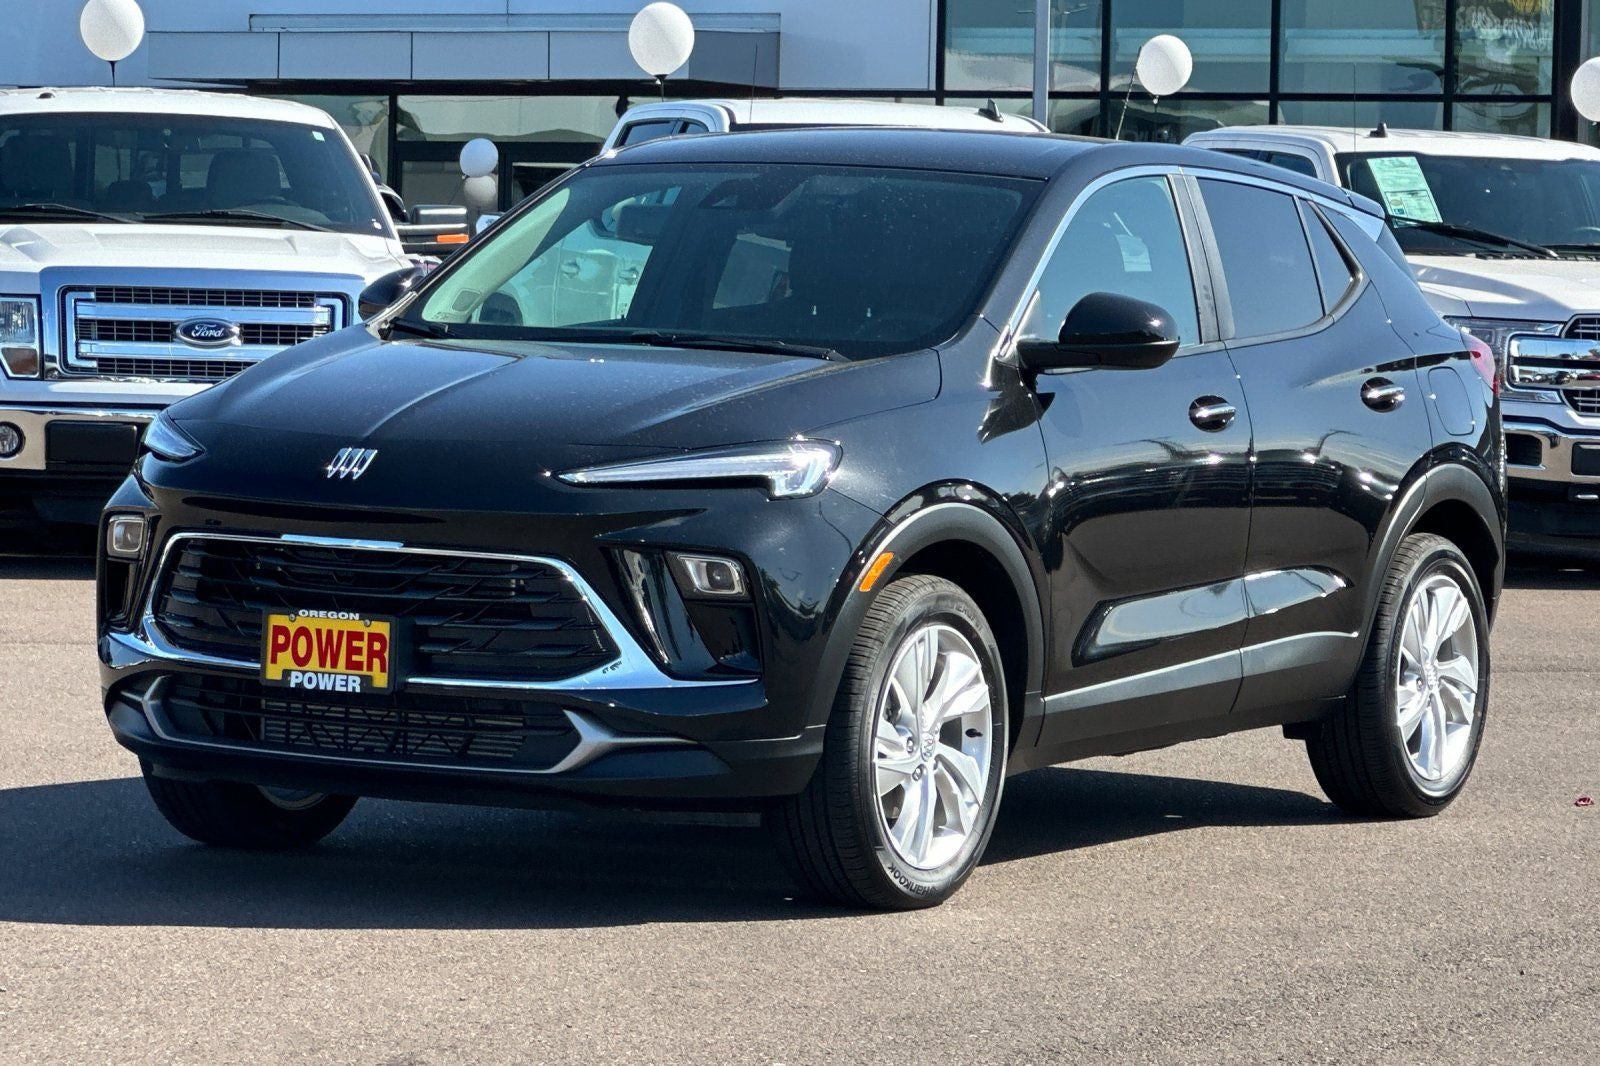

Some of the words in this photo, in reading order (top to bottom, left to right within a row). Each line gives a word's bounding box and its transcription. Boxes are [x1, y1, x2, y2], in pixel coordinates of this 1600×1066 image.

[191, 323, 224, 337] Ford
[298, 609, 360, 620] OREGON
[270, 625, 388, 673] POWER
[290, 671, 361, 692] POWER
